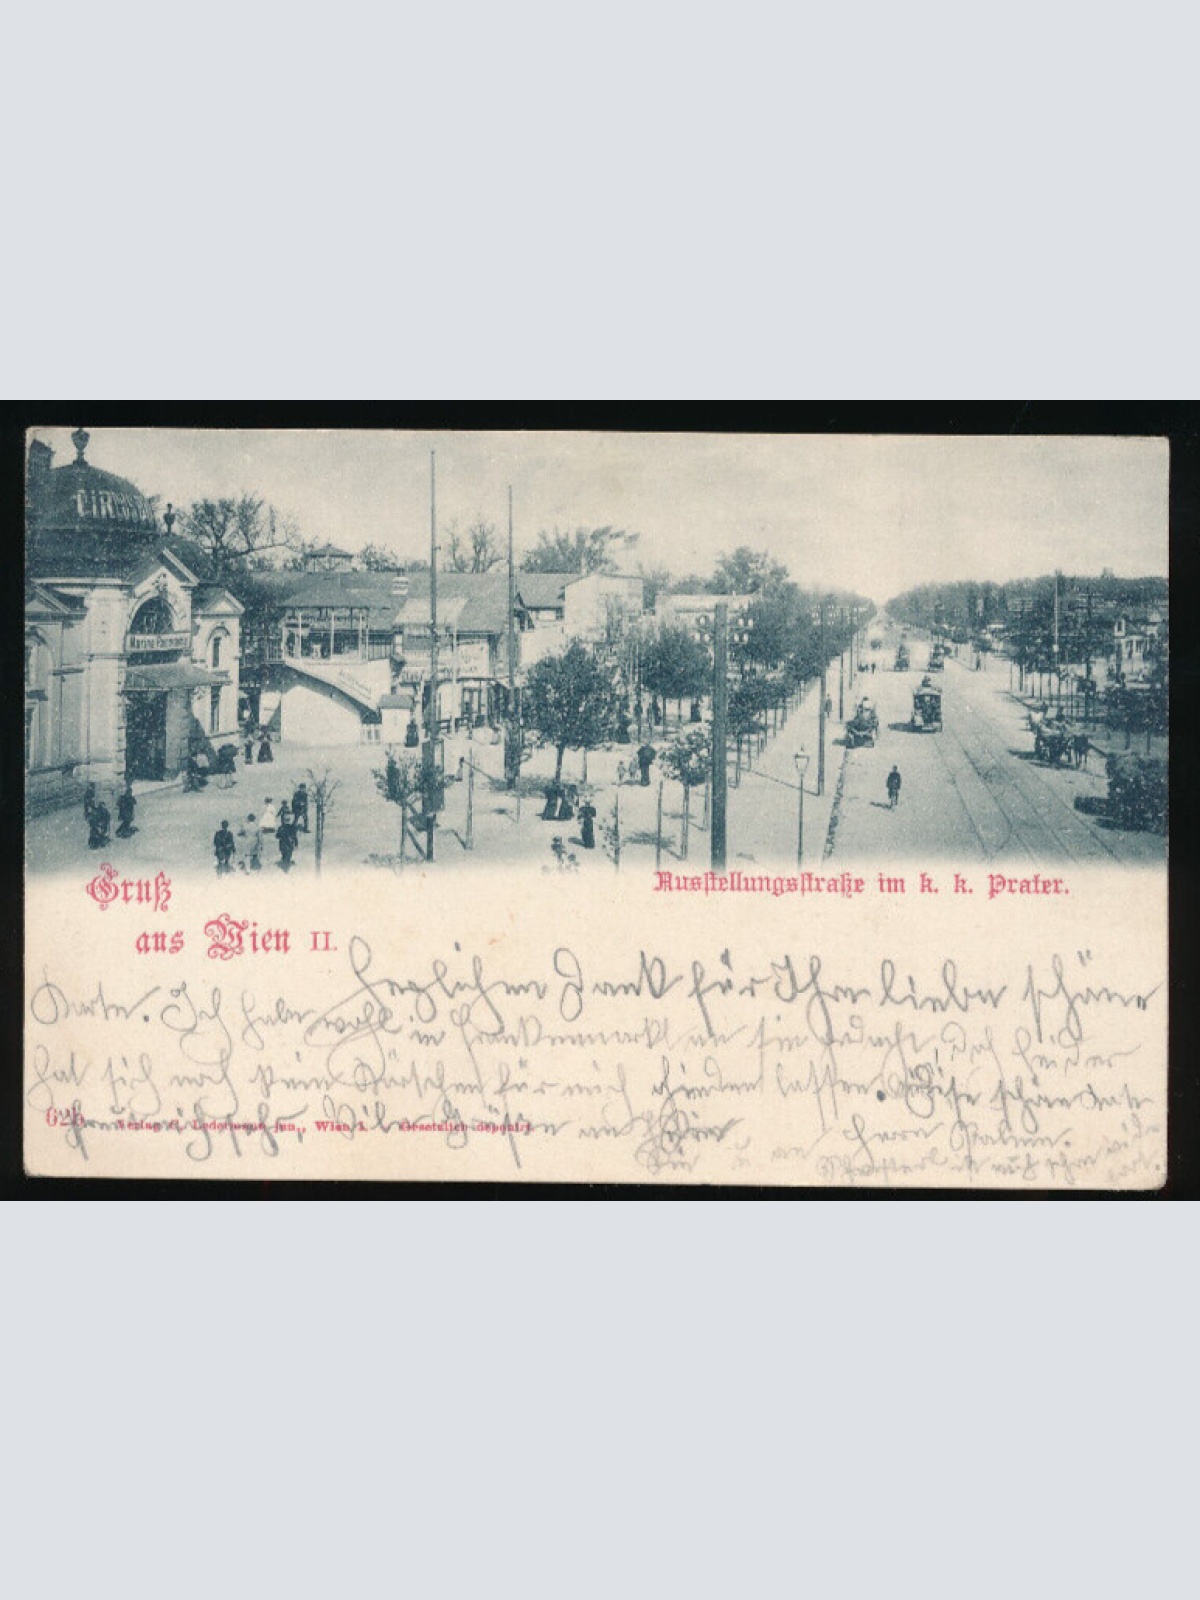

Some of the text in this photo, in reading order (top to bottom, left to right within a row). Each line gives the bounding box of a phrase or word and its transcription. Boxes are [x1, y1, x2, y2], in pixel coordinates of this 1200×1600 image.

[877, 872, 906, 895] im
[919, 872, 940, 895] k.
[953, 872, 974, 896] k.
[987, 872, 1070, 900] Prater.
[203, 912, 291, 961] Wien
[310, 930, 338, 952] II.
[553, 947, 684, 1022] Dank
